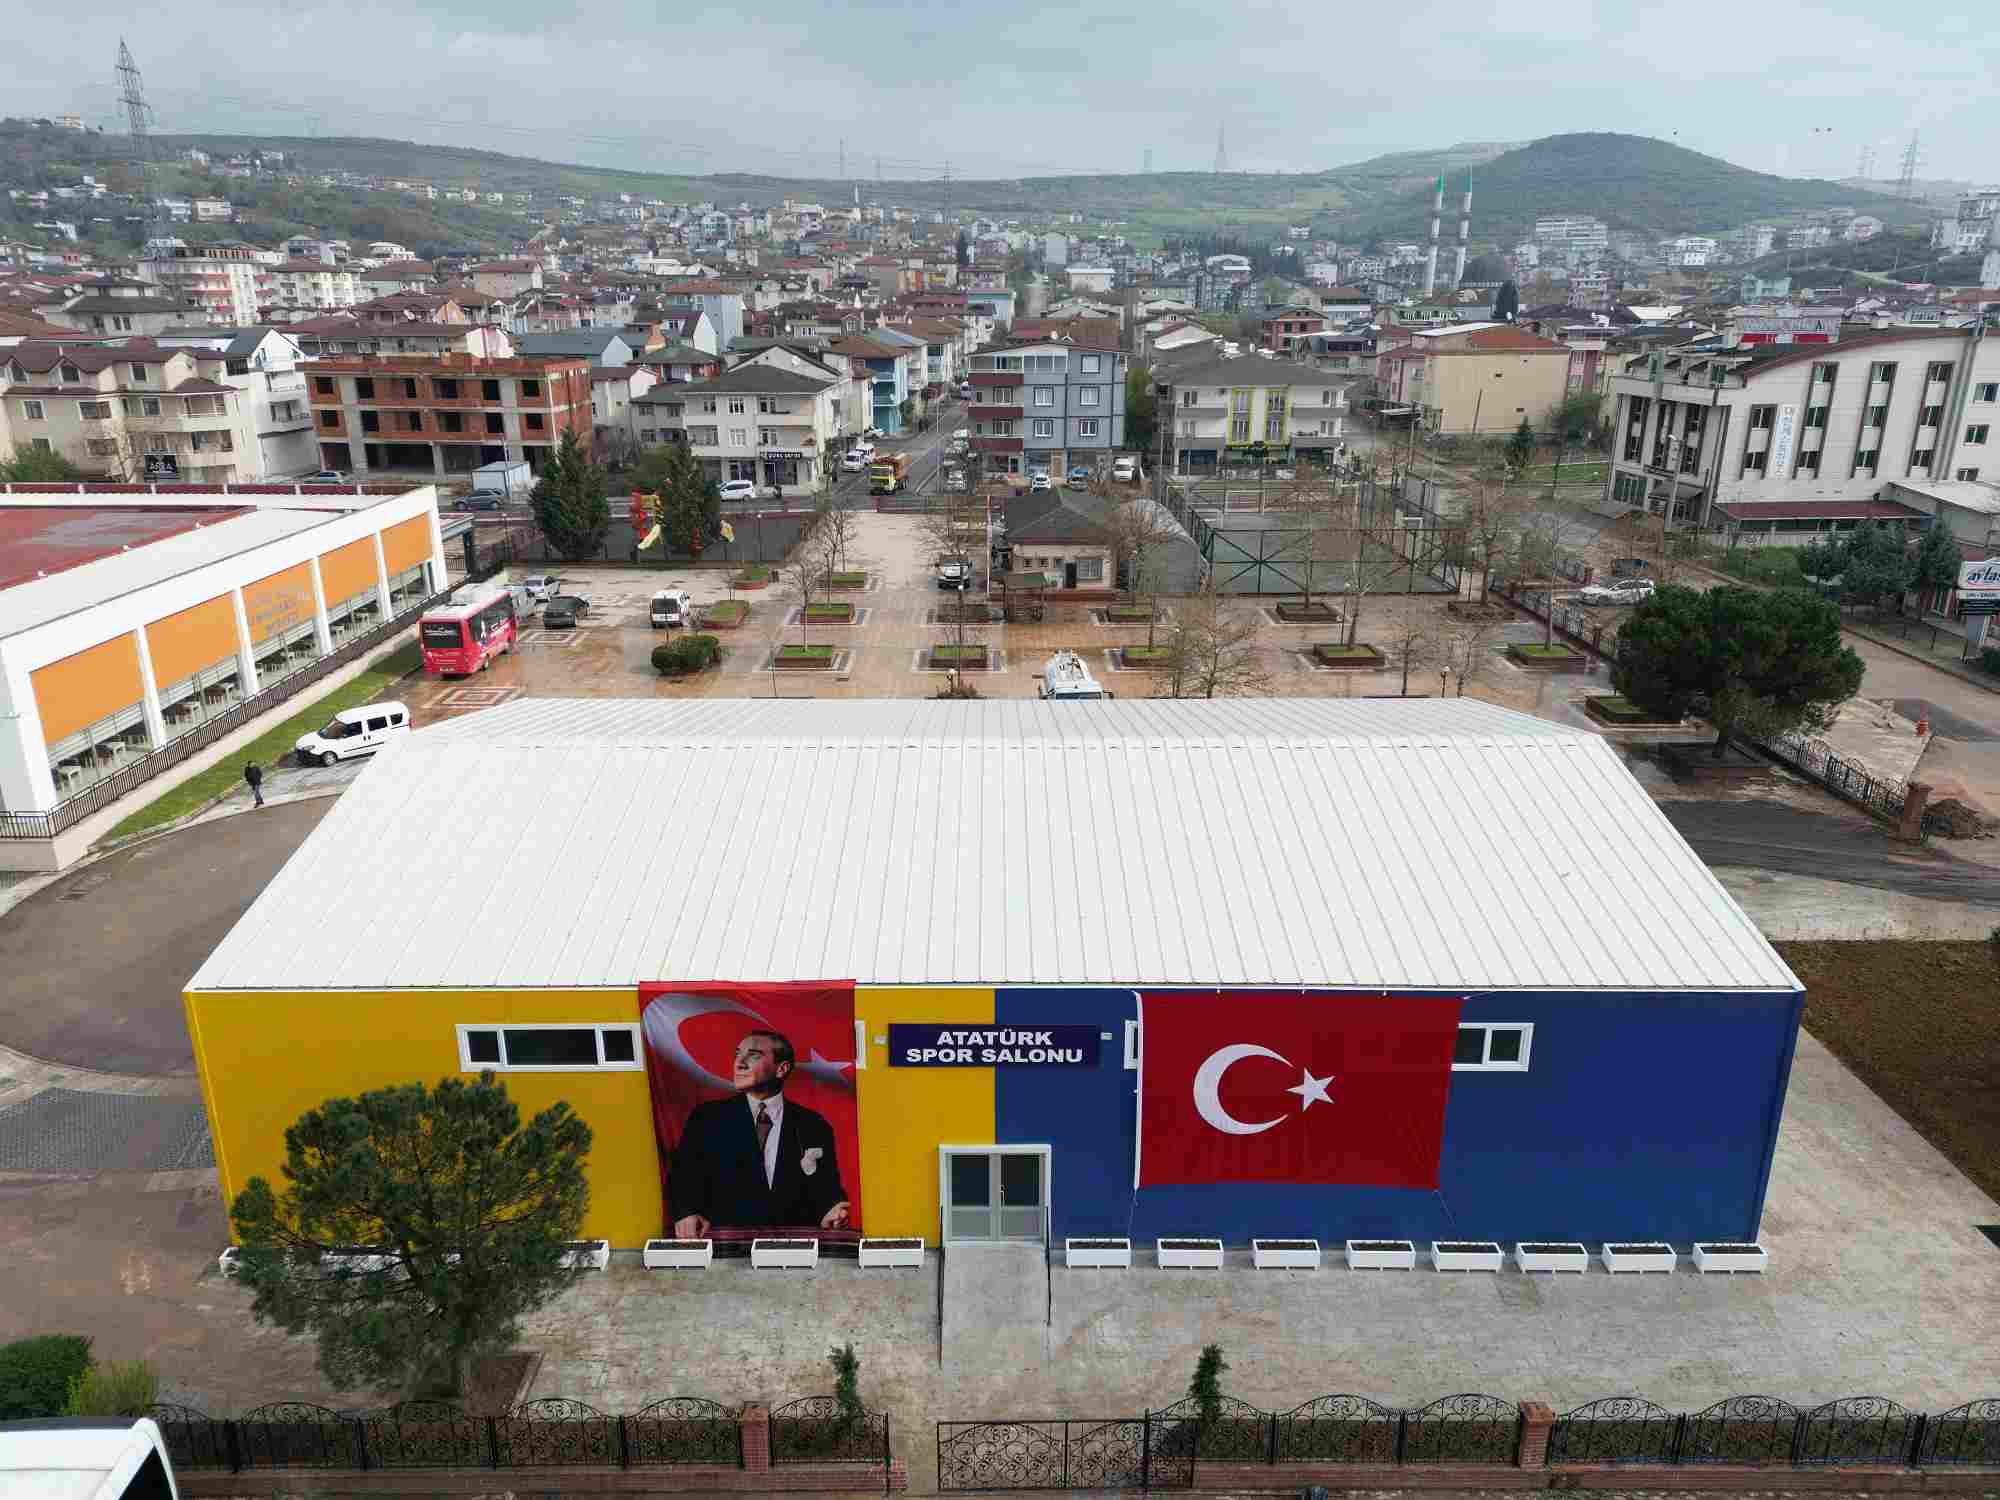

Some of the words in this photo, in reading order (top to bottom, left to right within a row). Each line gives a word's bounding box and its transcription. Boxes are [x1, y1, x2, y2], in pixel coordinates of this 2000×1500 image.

[937, 1029, 1053, 1045] ATATÜRK
[906, 1049, 973, 1062] SPOR
[982, 1049, 1083, 1062] SALONU
